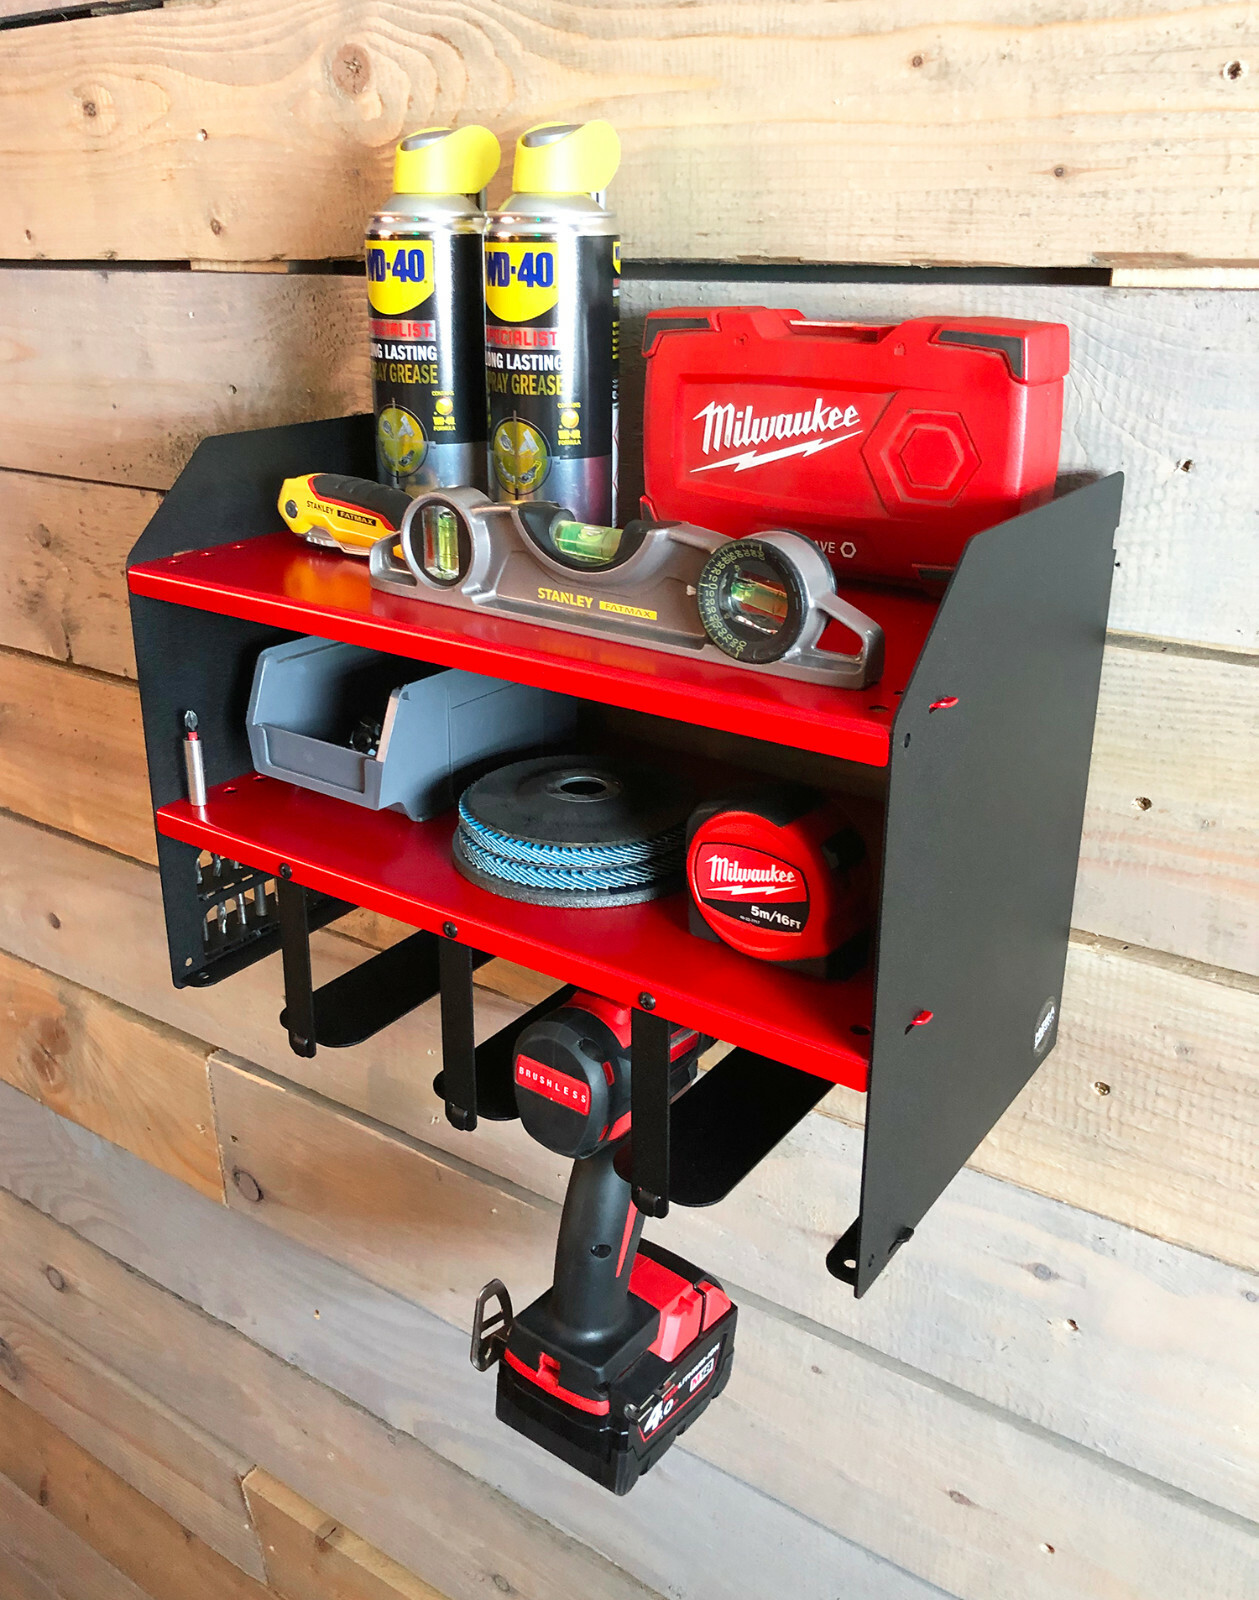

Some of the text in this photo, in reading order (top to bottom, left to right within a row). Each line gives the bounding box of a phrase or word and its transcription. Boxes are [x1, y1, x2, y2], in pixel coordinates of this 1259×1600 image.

[486, 251, 554, 287] WD-40
[384, 344, 438, 361] LASTING
[506, 353, 563, 371] LASTING
[389, 363, 439, 384] GREASE
[511, 373, 563, 396] GREASE
[692, 398, 861, 455] Milwaukee
[306, 500, 373, 526] STANLEY FATMAX
[537, 587, 651, 618] STANLEY FATMAX
[704, 854, 797, 883] Milwaukee
[750, 905, 802, 929] 5m/16FT
[518, 1066, 586, 1103] BRUSHLESS
